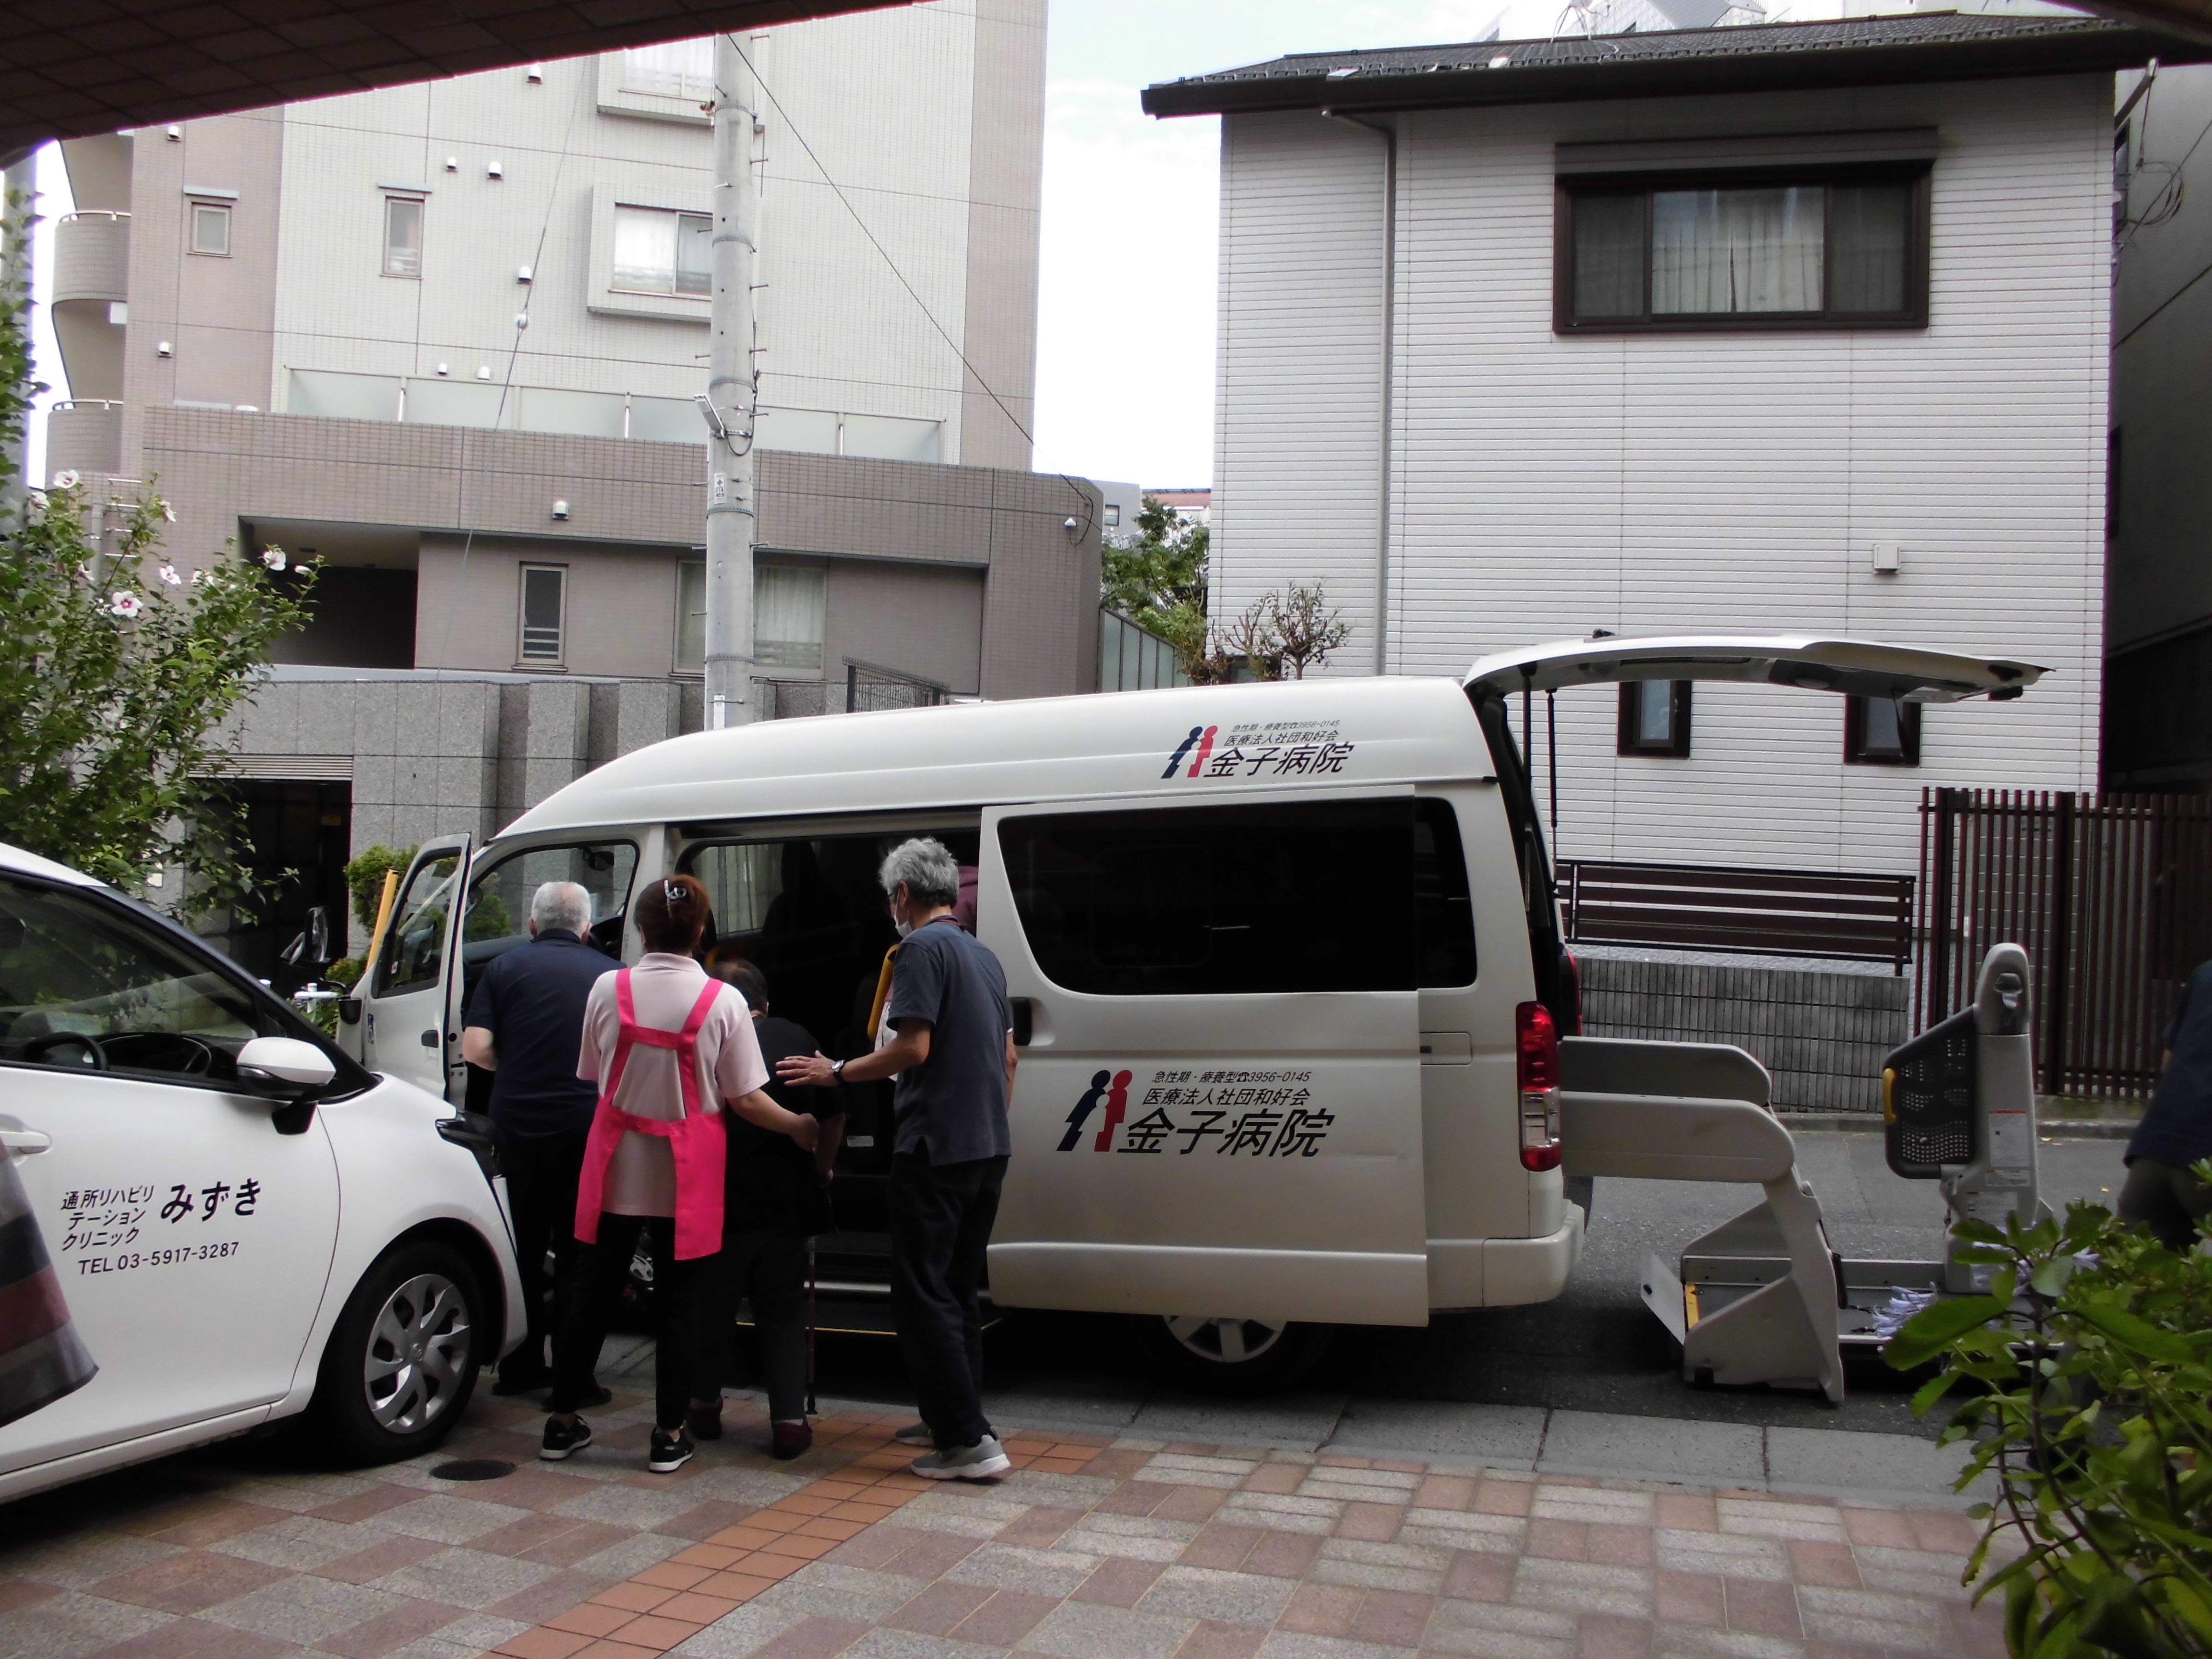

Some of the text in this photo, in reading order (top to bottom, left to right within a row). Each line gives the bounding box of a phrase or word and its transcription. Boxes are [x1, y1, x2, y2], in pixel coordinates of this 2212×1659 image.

[1224, 730, 1338, 746] 医療法人社団和好会
[1203, 742, 1354, 778] 金子病院
[1142, 1088, 1310, 1106] 医療法人社団和好会
[1117, 1107, 1335, 1157] 金子病院
[60, 1185, 155, 1210] 通所リハビリ
[161, 1178, 261, 1224] みずき
[69, 1208, 146, 1230] テーション
[62, 1227, 140, 1251] クリニック
